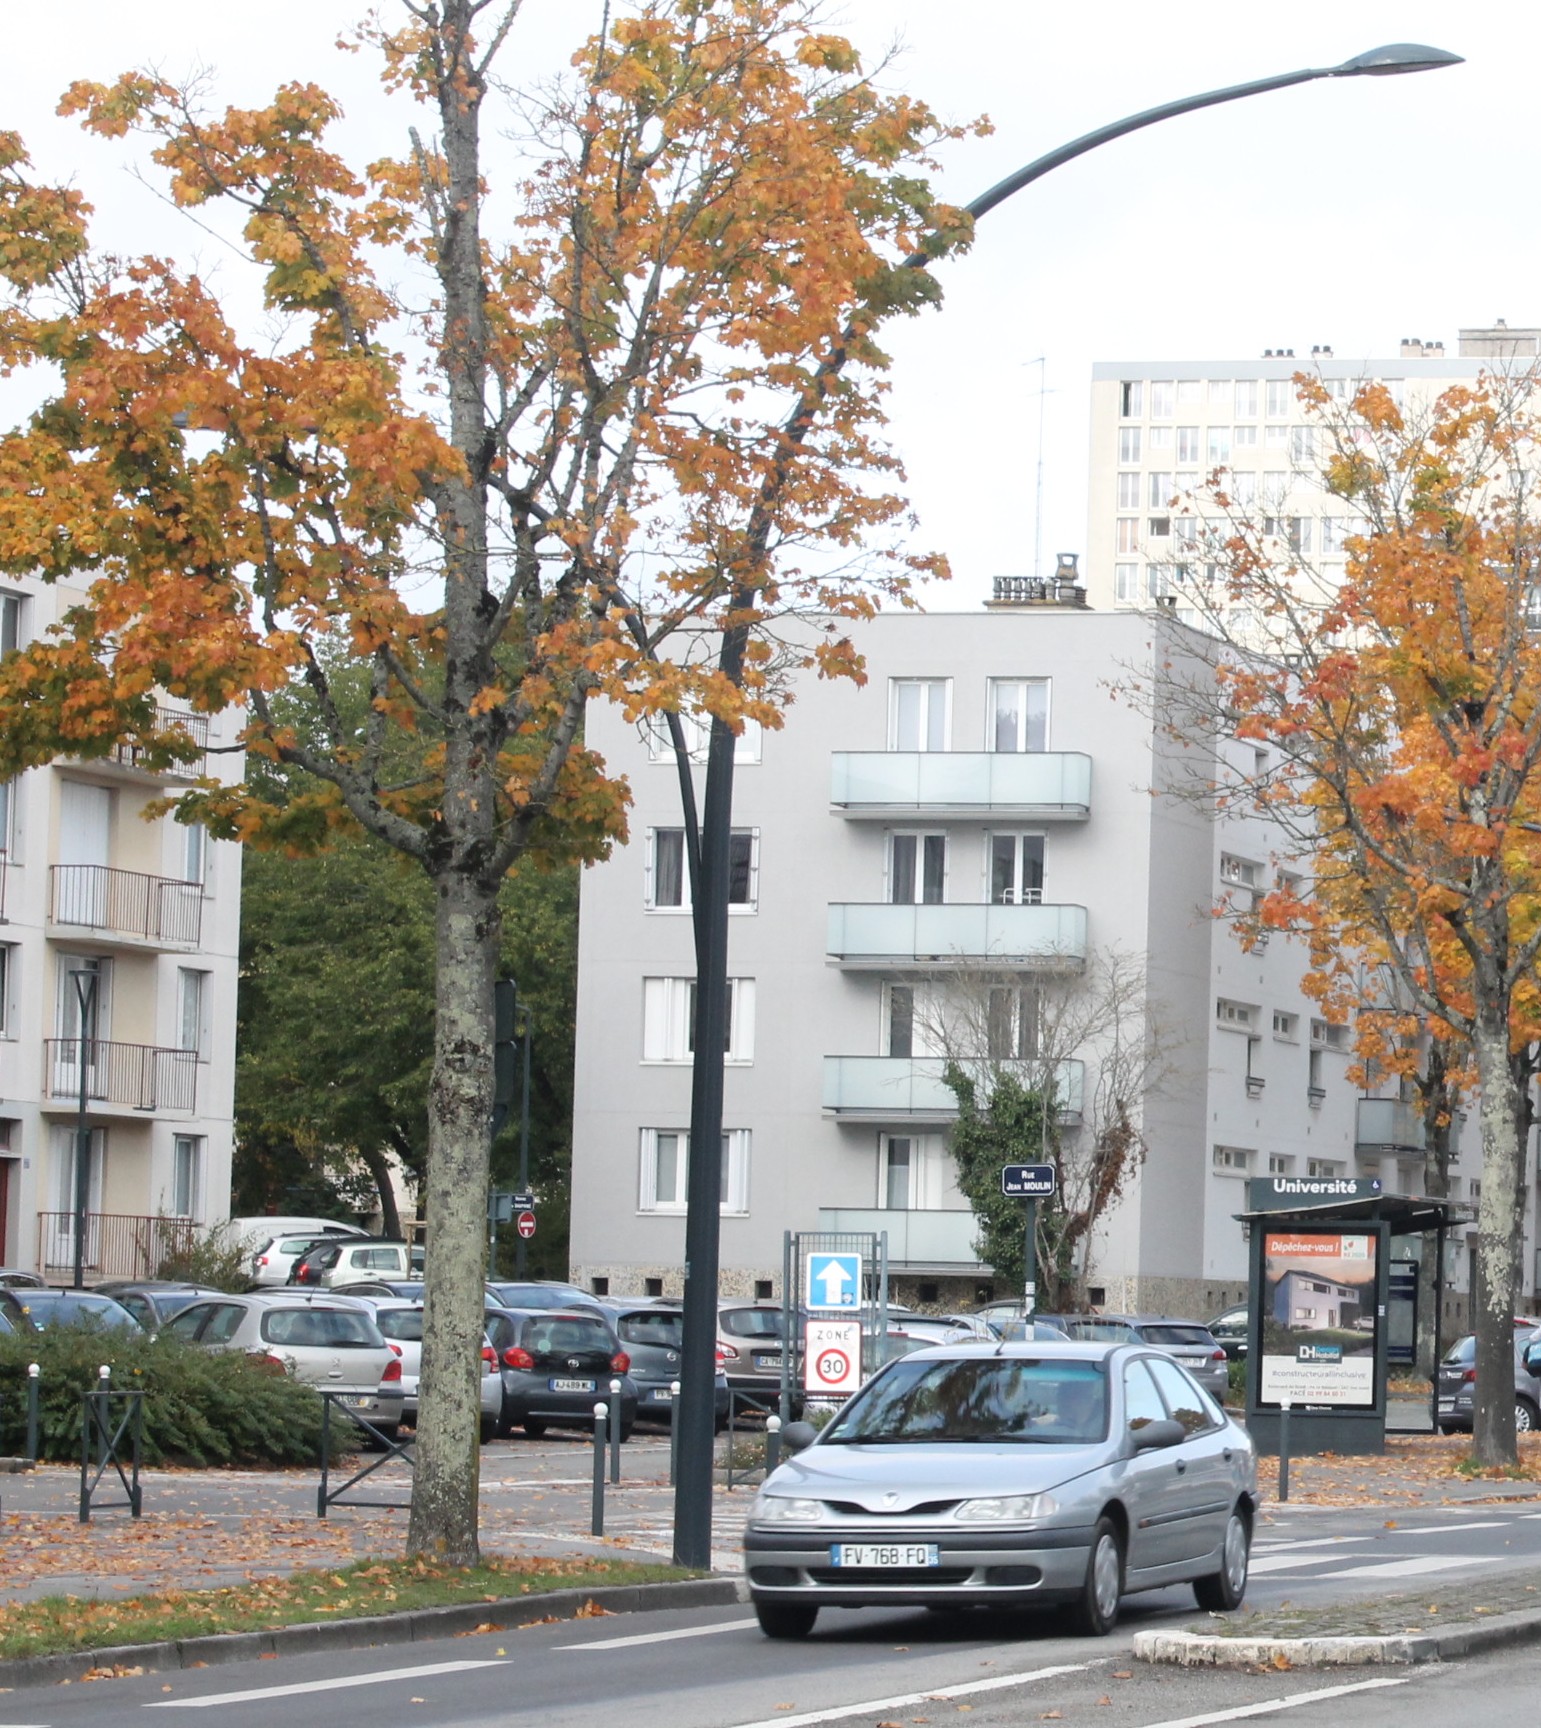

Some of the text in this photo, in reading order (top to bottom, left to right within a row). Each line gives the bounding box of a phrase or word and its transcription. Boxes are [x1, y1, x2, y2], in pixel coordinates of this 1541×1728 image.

[1024, 1182, 1051, 1190] MOULIN
[1273, 1179, 1357, 1194] Université
[817, 1330, 849, 1340] ZONE
[823, 1359, 843, 1374] 30
[845, 1548, 926, 1564] FV-768-FQ
